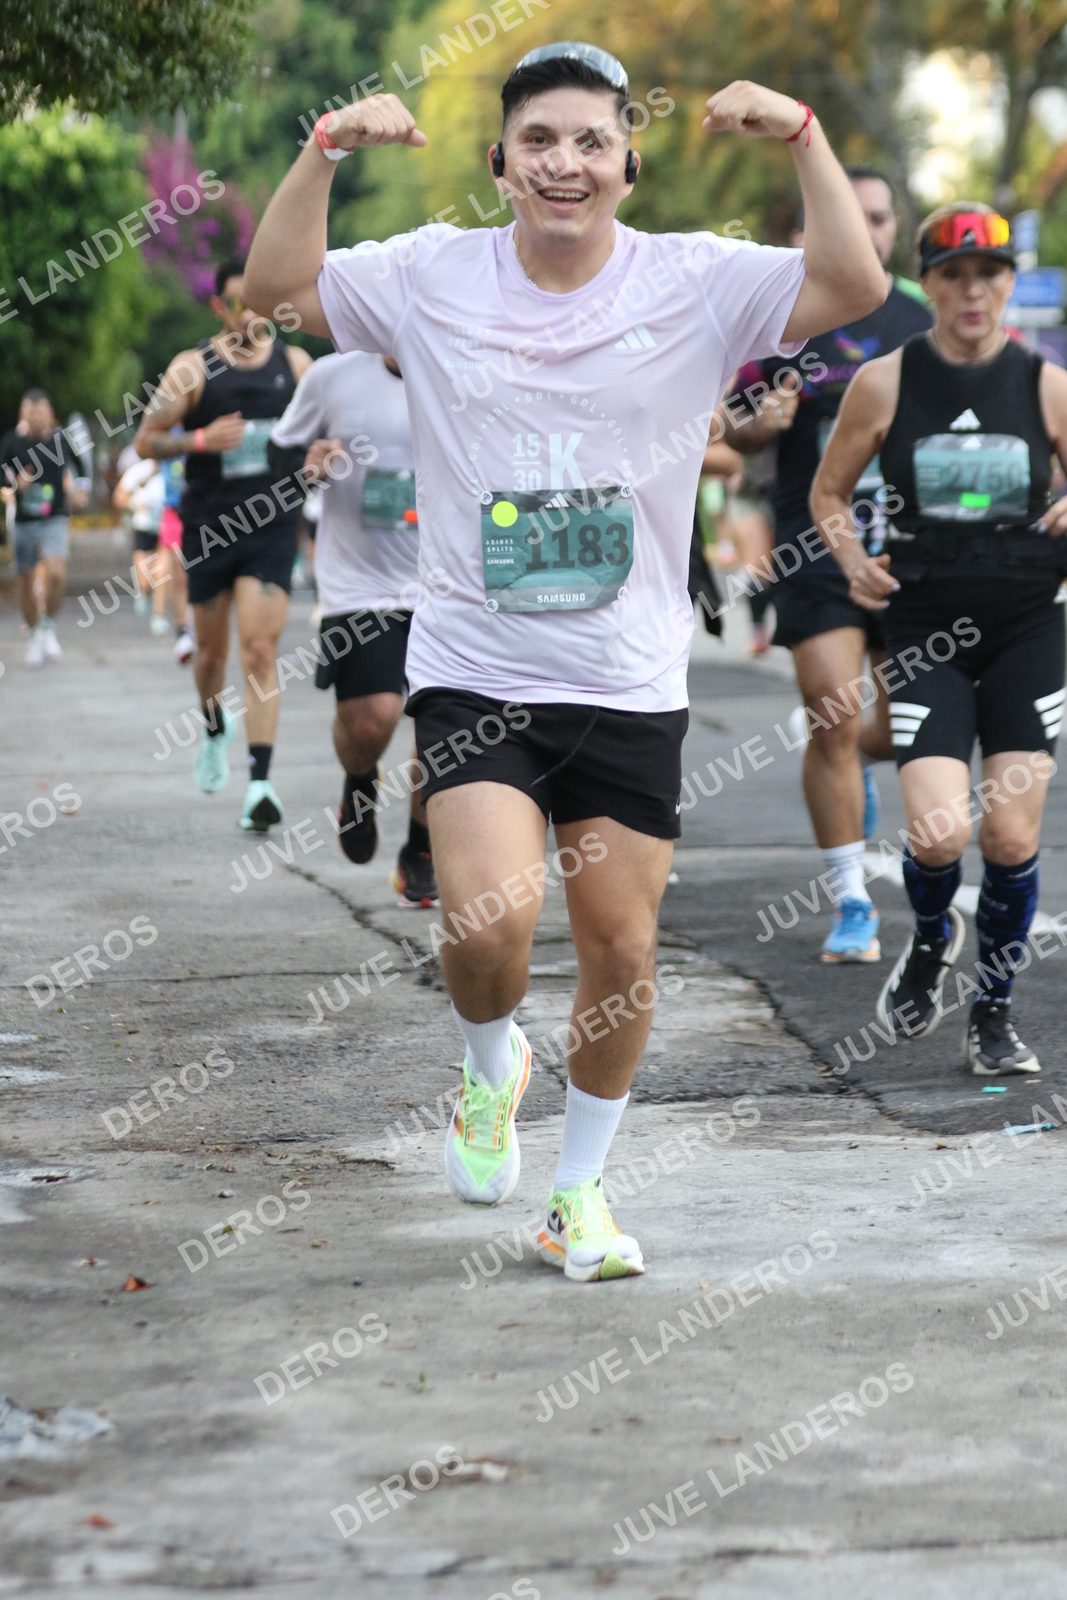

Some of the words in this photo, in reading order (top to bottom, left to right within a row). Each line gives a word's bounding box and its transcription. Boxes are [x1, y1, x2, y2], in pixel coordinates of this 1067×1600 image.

[512, 433, 541, 457] 15
[549, 432, 586, 489] K
[512, 469, 543, 491] 30
[525, 522, 629, 570] 1183
[537, 593, 586, 603] SAMSUNG
